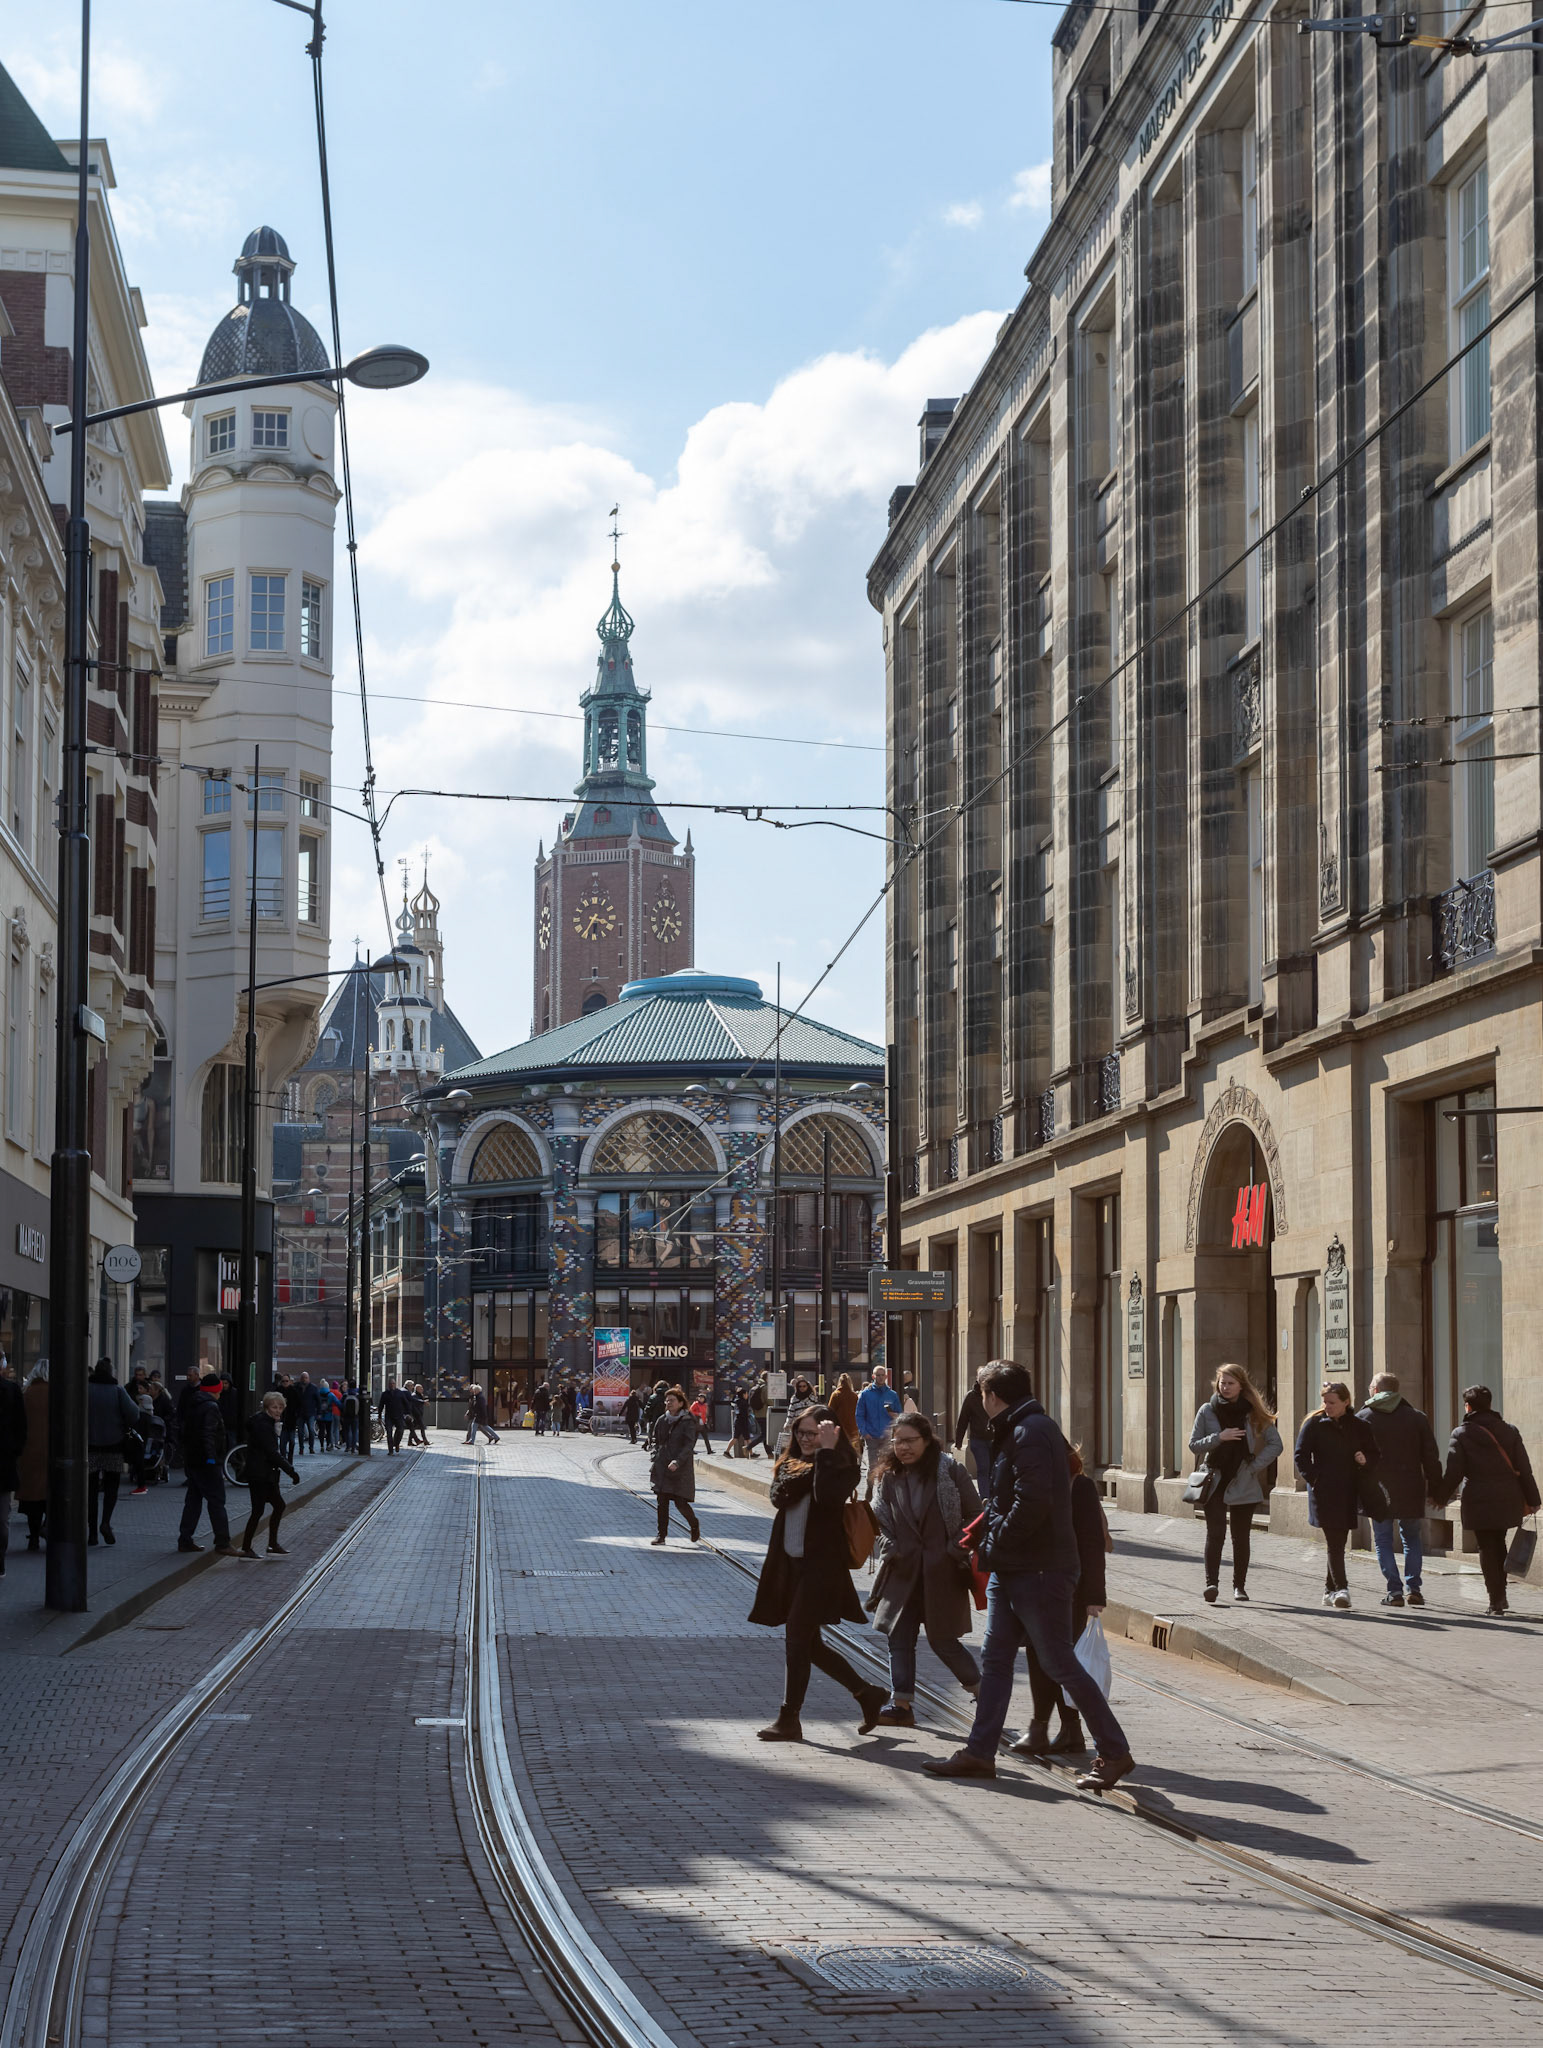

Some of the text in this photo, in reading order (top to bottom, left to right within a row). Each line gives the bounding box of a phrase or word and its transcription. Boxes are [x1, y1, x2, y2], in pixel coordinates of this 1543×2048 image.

[1139, 68, 1183, 164] MAISON
[1187, 28, 1208, 84] DE
[1232, 1182, 1267, 1248] H&M
[109, 1254, 138, 1268] noë
[630, 1345, 645, 1357] HE
[648, 1344, 689, 1358] STING
